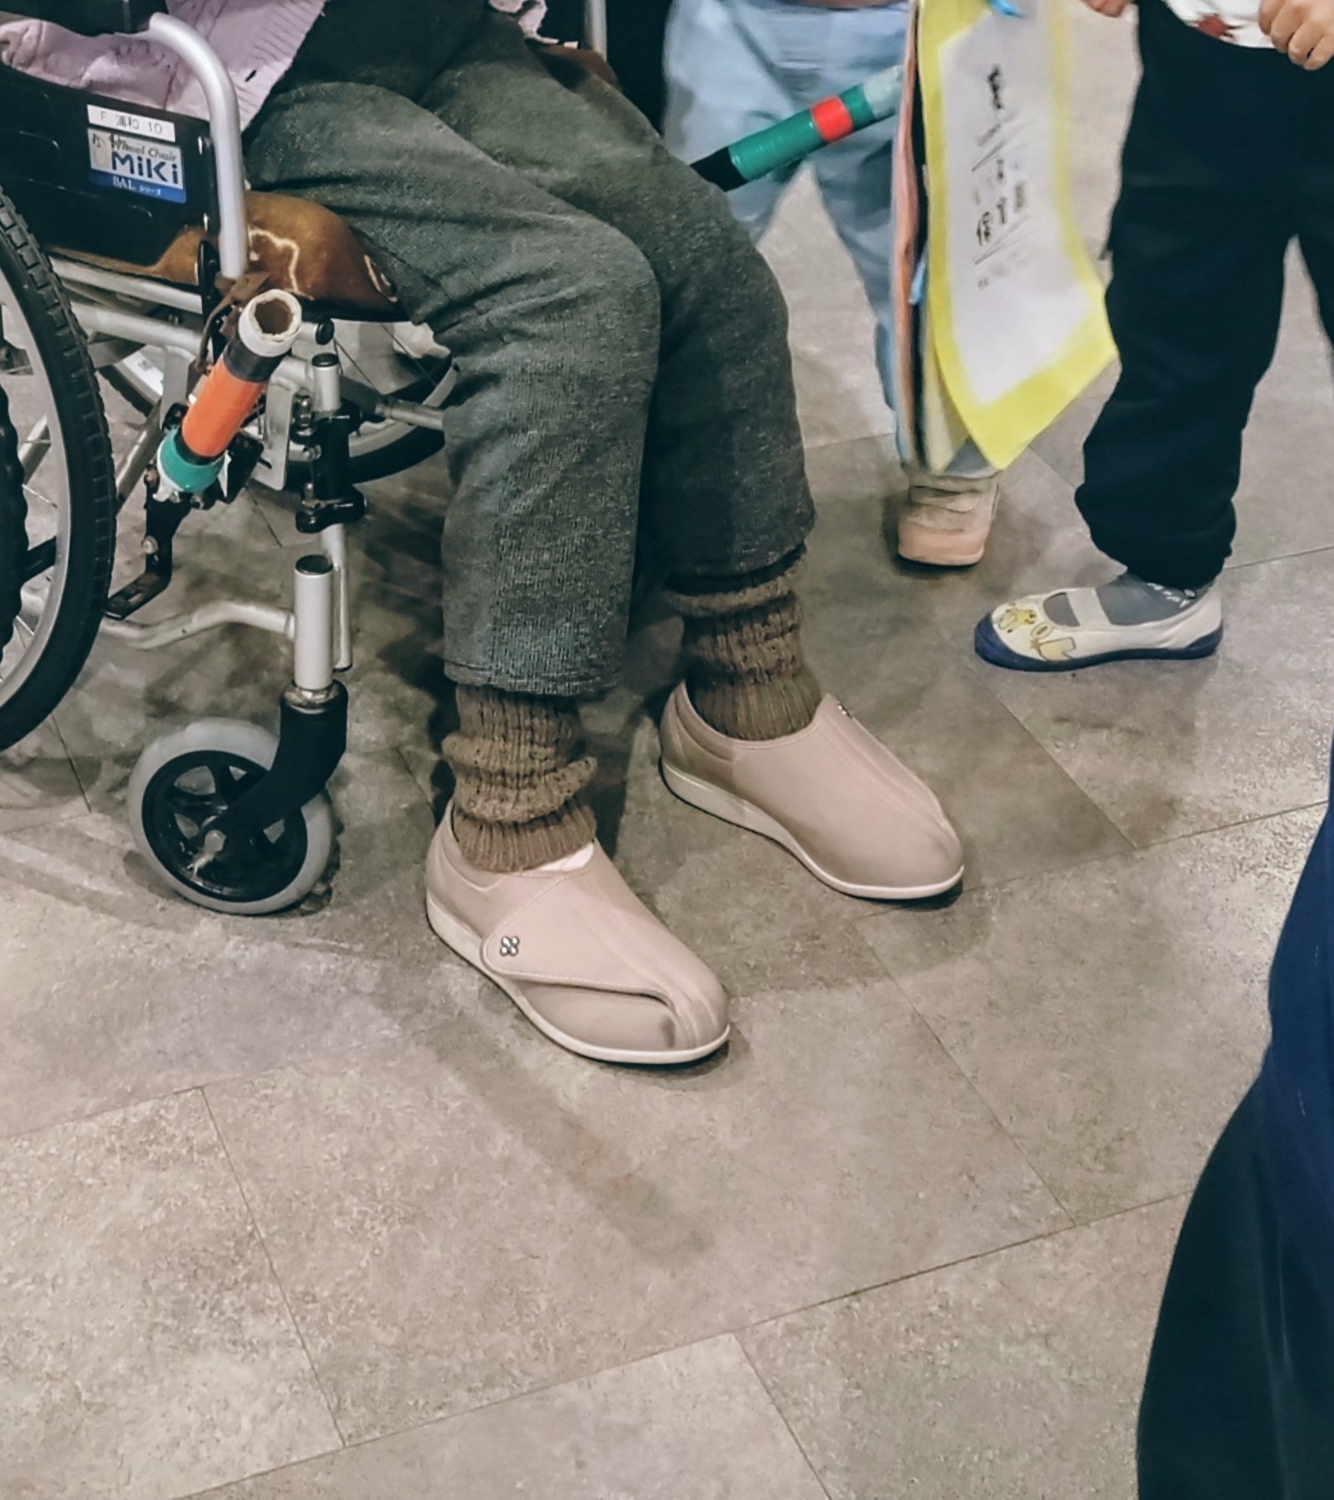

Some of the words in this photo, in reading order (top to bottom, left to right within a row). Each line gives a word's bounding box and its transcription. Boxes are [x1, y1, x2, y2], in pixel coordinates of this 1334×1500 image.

[148, 122, 163, 135] 10
[149, 146, 177, 162] Chair
[113, 176, 136, 191] BAL
